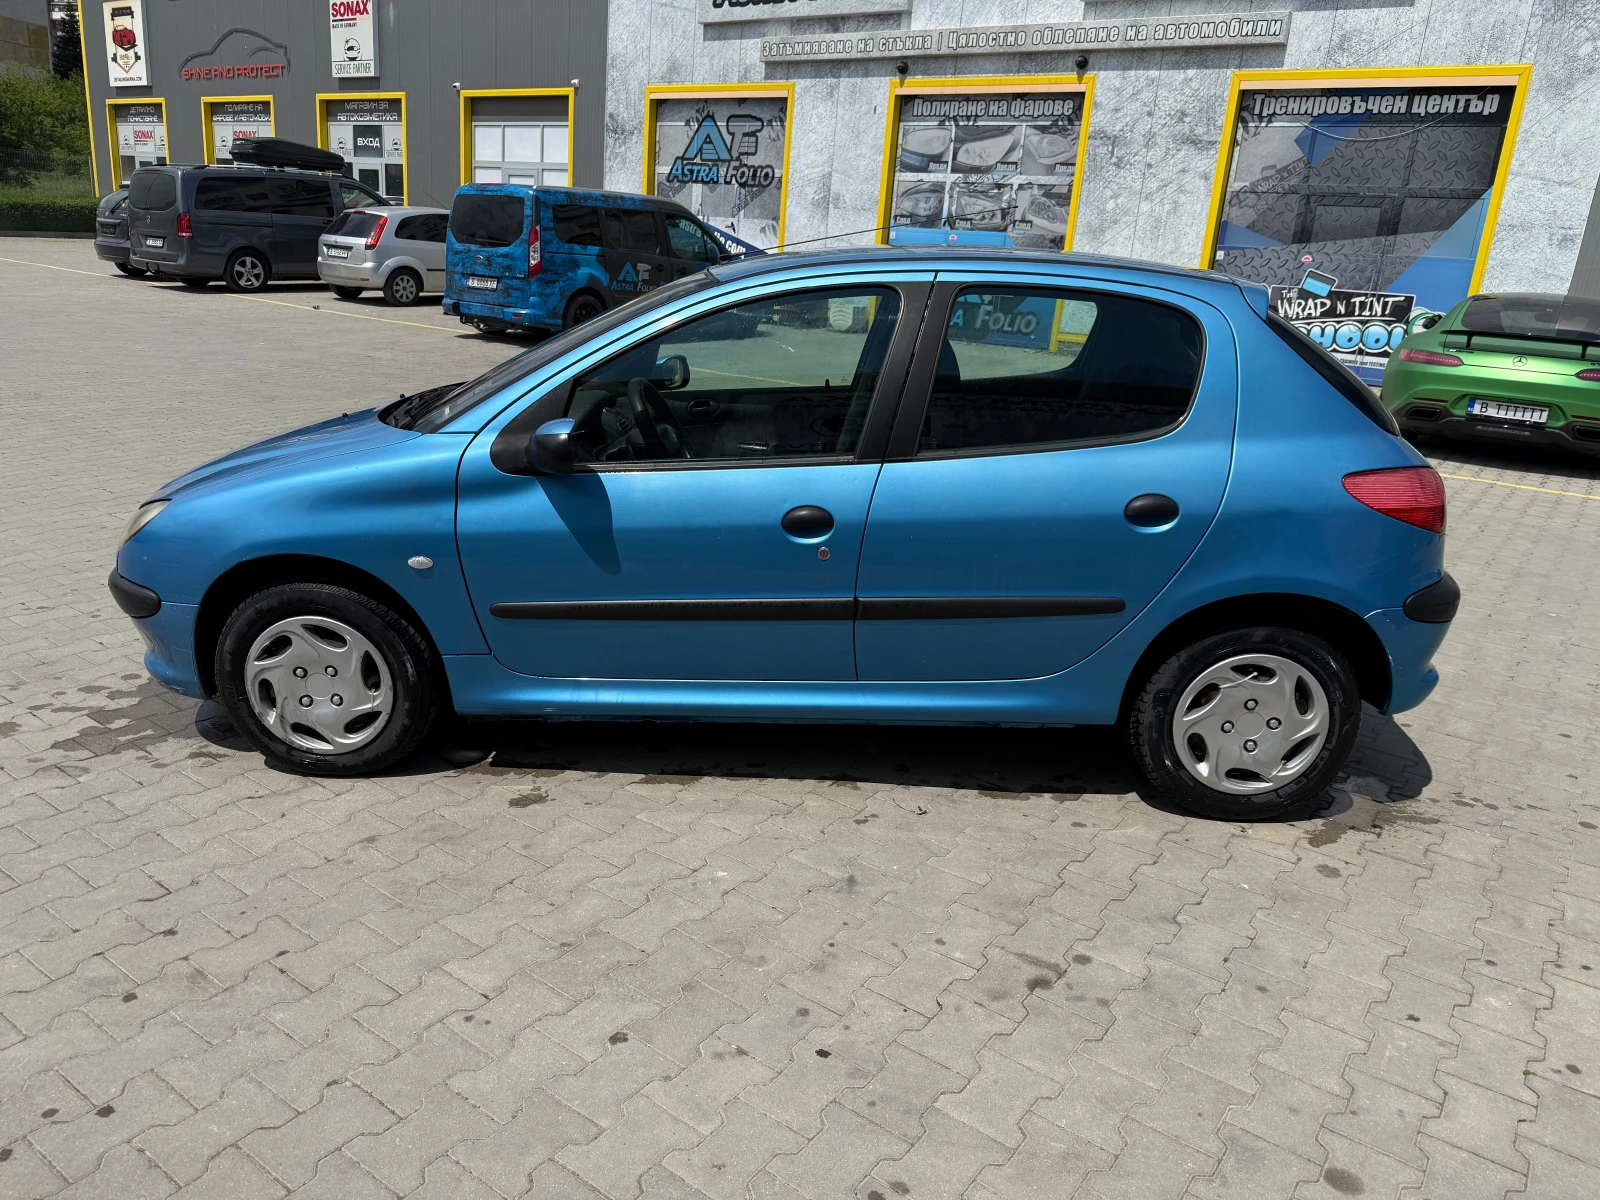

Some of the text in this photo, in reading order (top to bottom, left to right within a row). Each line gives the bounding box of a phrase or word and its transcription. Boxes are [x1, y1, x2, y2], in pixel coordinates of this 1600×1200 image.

[331, 0, 369, 18] SONAX
[763, 39, 852, 57] Затъмняване
[857, 38, 874, 53] на
[879, 34, 932, 51] стъкла
[948, 30, 1026, 50] Цялостно
[1032, 25, 1120, 45] облепяне
[1125, 24, 1148, 42] на
[1154, 18, 1283, 41] автомобили
[182, 63, 285, 80] SHINE AND PROTECT
[353, 62, 372, 74] PARTNER
[379, 101, 389, 109] ЗА
[912, 98, 1074, 118] Полиране на фарове
[1253, 93, 1501, 117] Тренировъчен център
[134, 129, 154, 140] SONAX
[233, 130, 257, 139] SONAX
[357, 137, 381, 148] ВХОД
[667, 158, 774, 186] ASTRA FOLIO
[611, 280, 635, 292] ASTRA
[1277, 296, 1405, 320] WRAP N TINT
[974, 304, 1037, 334] FOLIO
[1480, 402, 1489, 413] B
